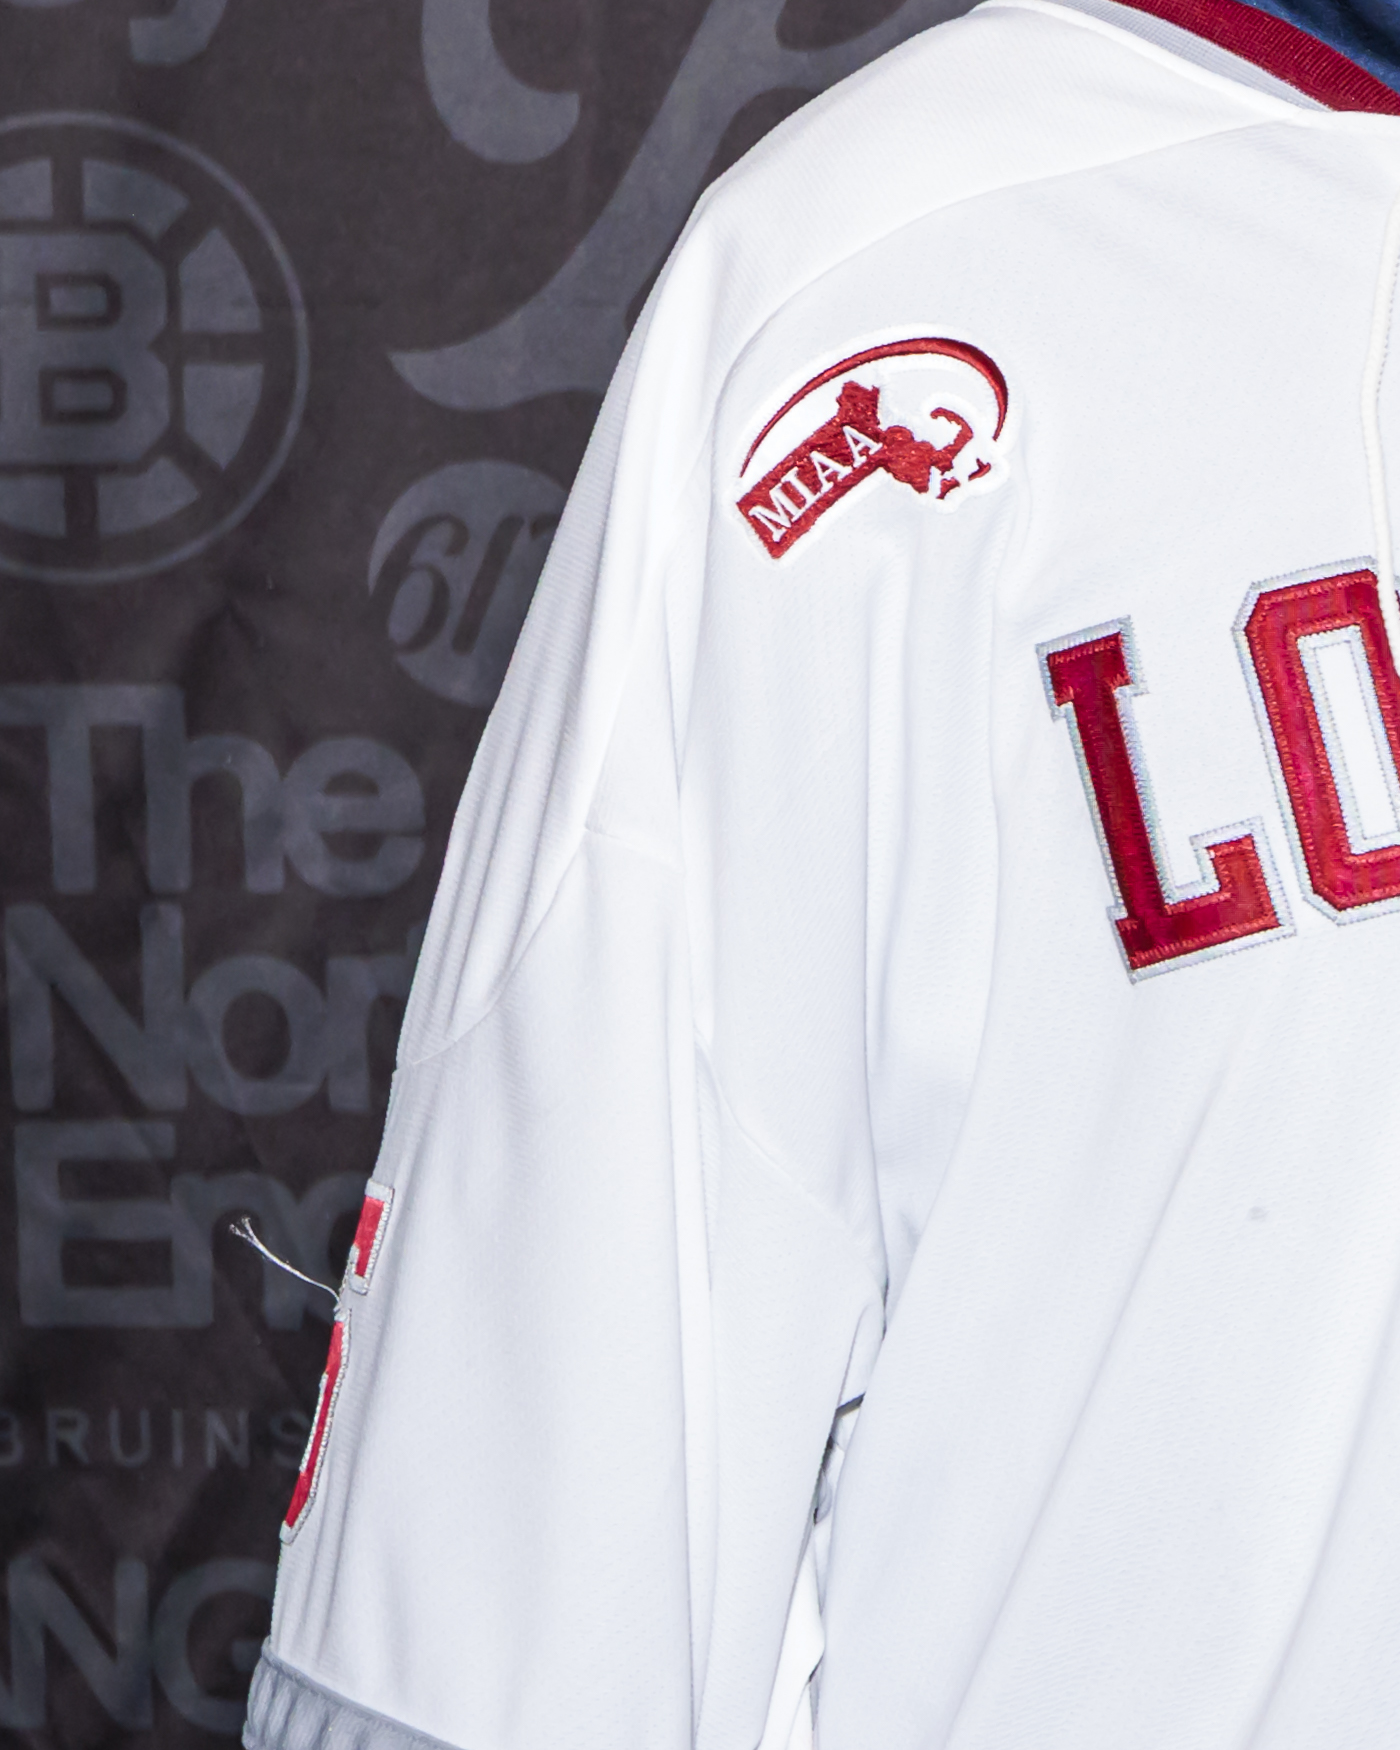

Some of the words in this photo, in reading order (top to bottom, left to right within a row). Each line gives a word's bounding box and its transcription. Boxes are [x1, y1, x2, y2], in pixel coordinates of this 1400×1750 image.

[748, 425, 883, 542] MIAA
[378, 510, 562, 656] 61
[0, 682, 426, 898] The
[4, 902, 425, 1117] Nor
